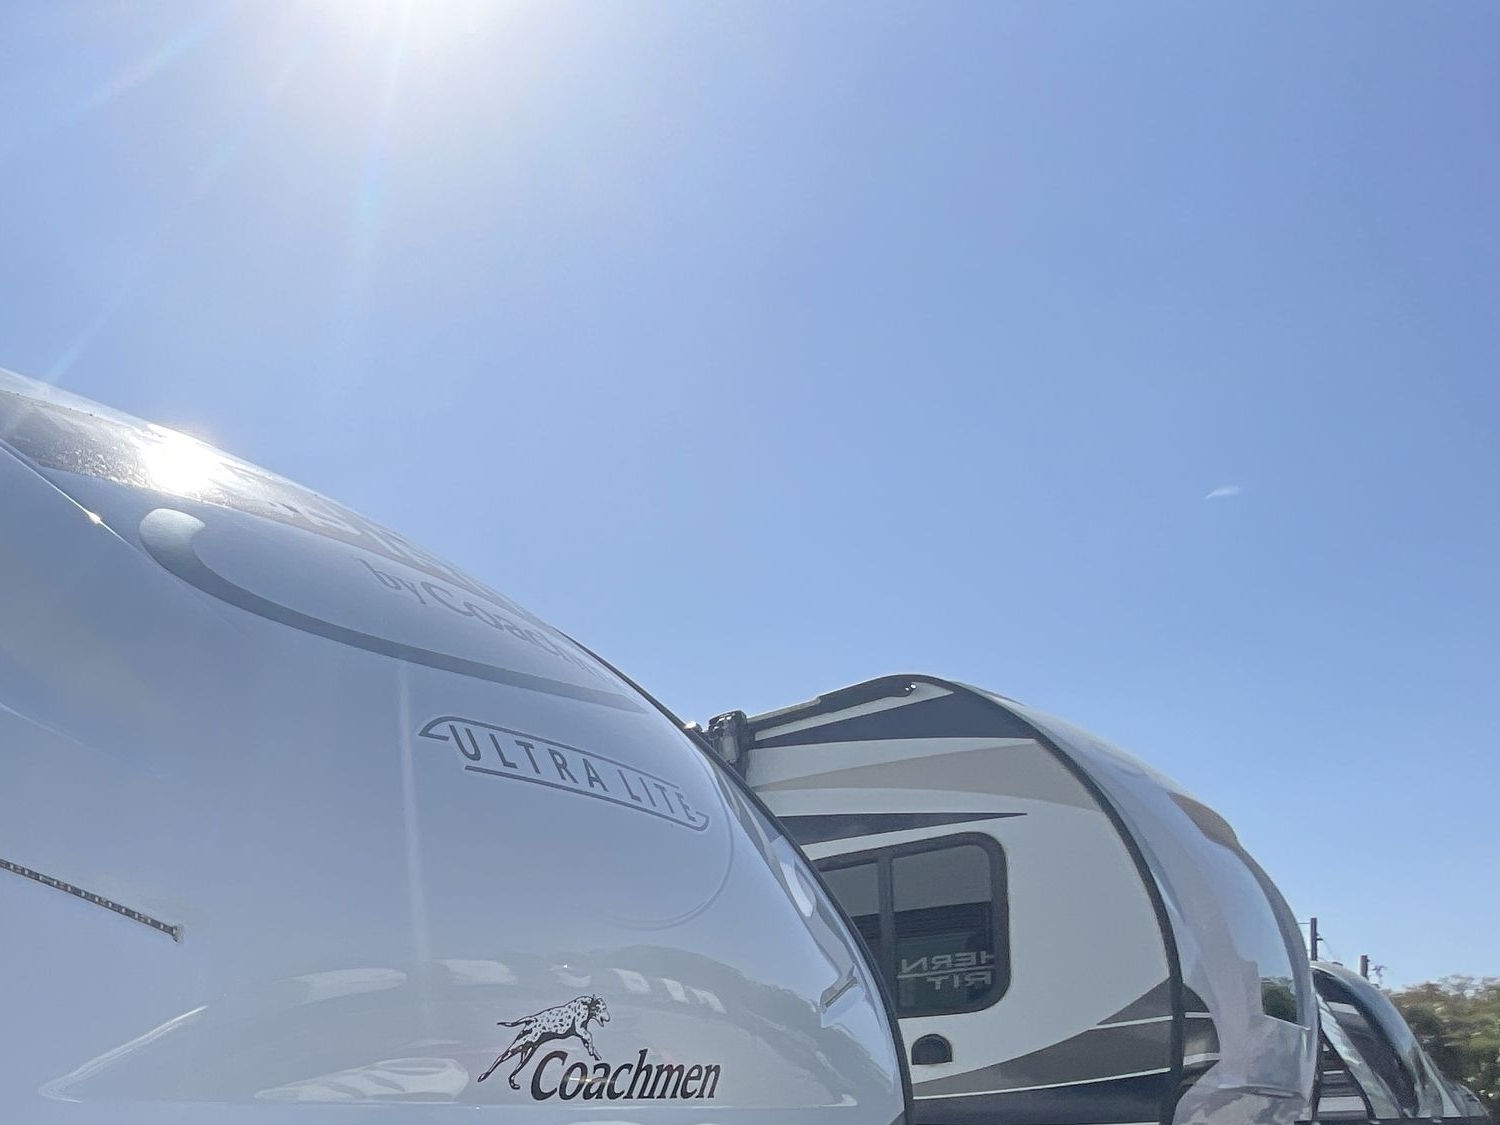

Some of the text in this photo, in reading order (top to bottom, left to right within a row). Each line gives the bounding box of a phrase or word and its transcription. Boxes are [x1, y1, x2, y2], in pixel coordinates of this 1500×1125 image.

[448, 724, 699, 823] ULTRA LITE
[530, 1048, 721, 1101] Coachmen
